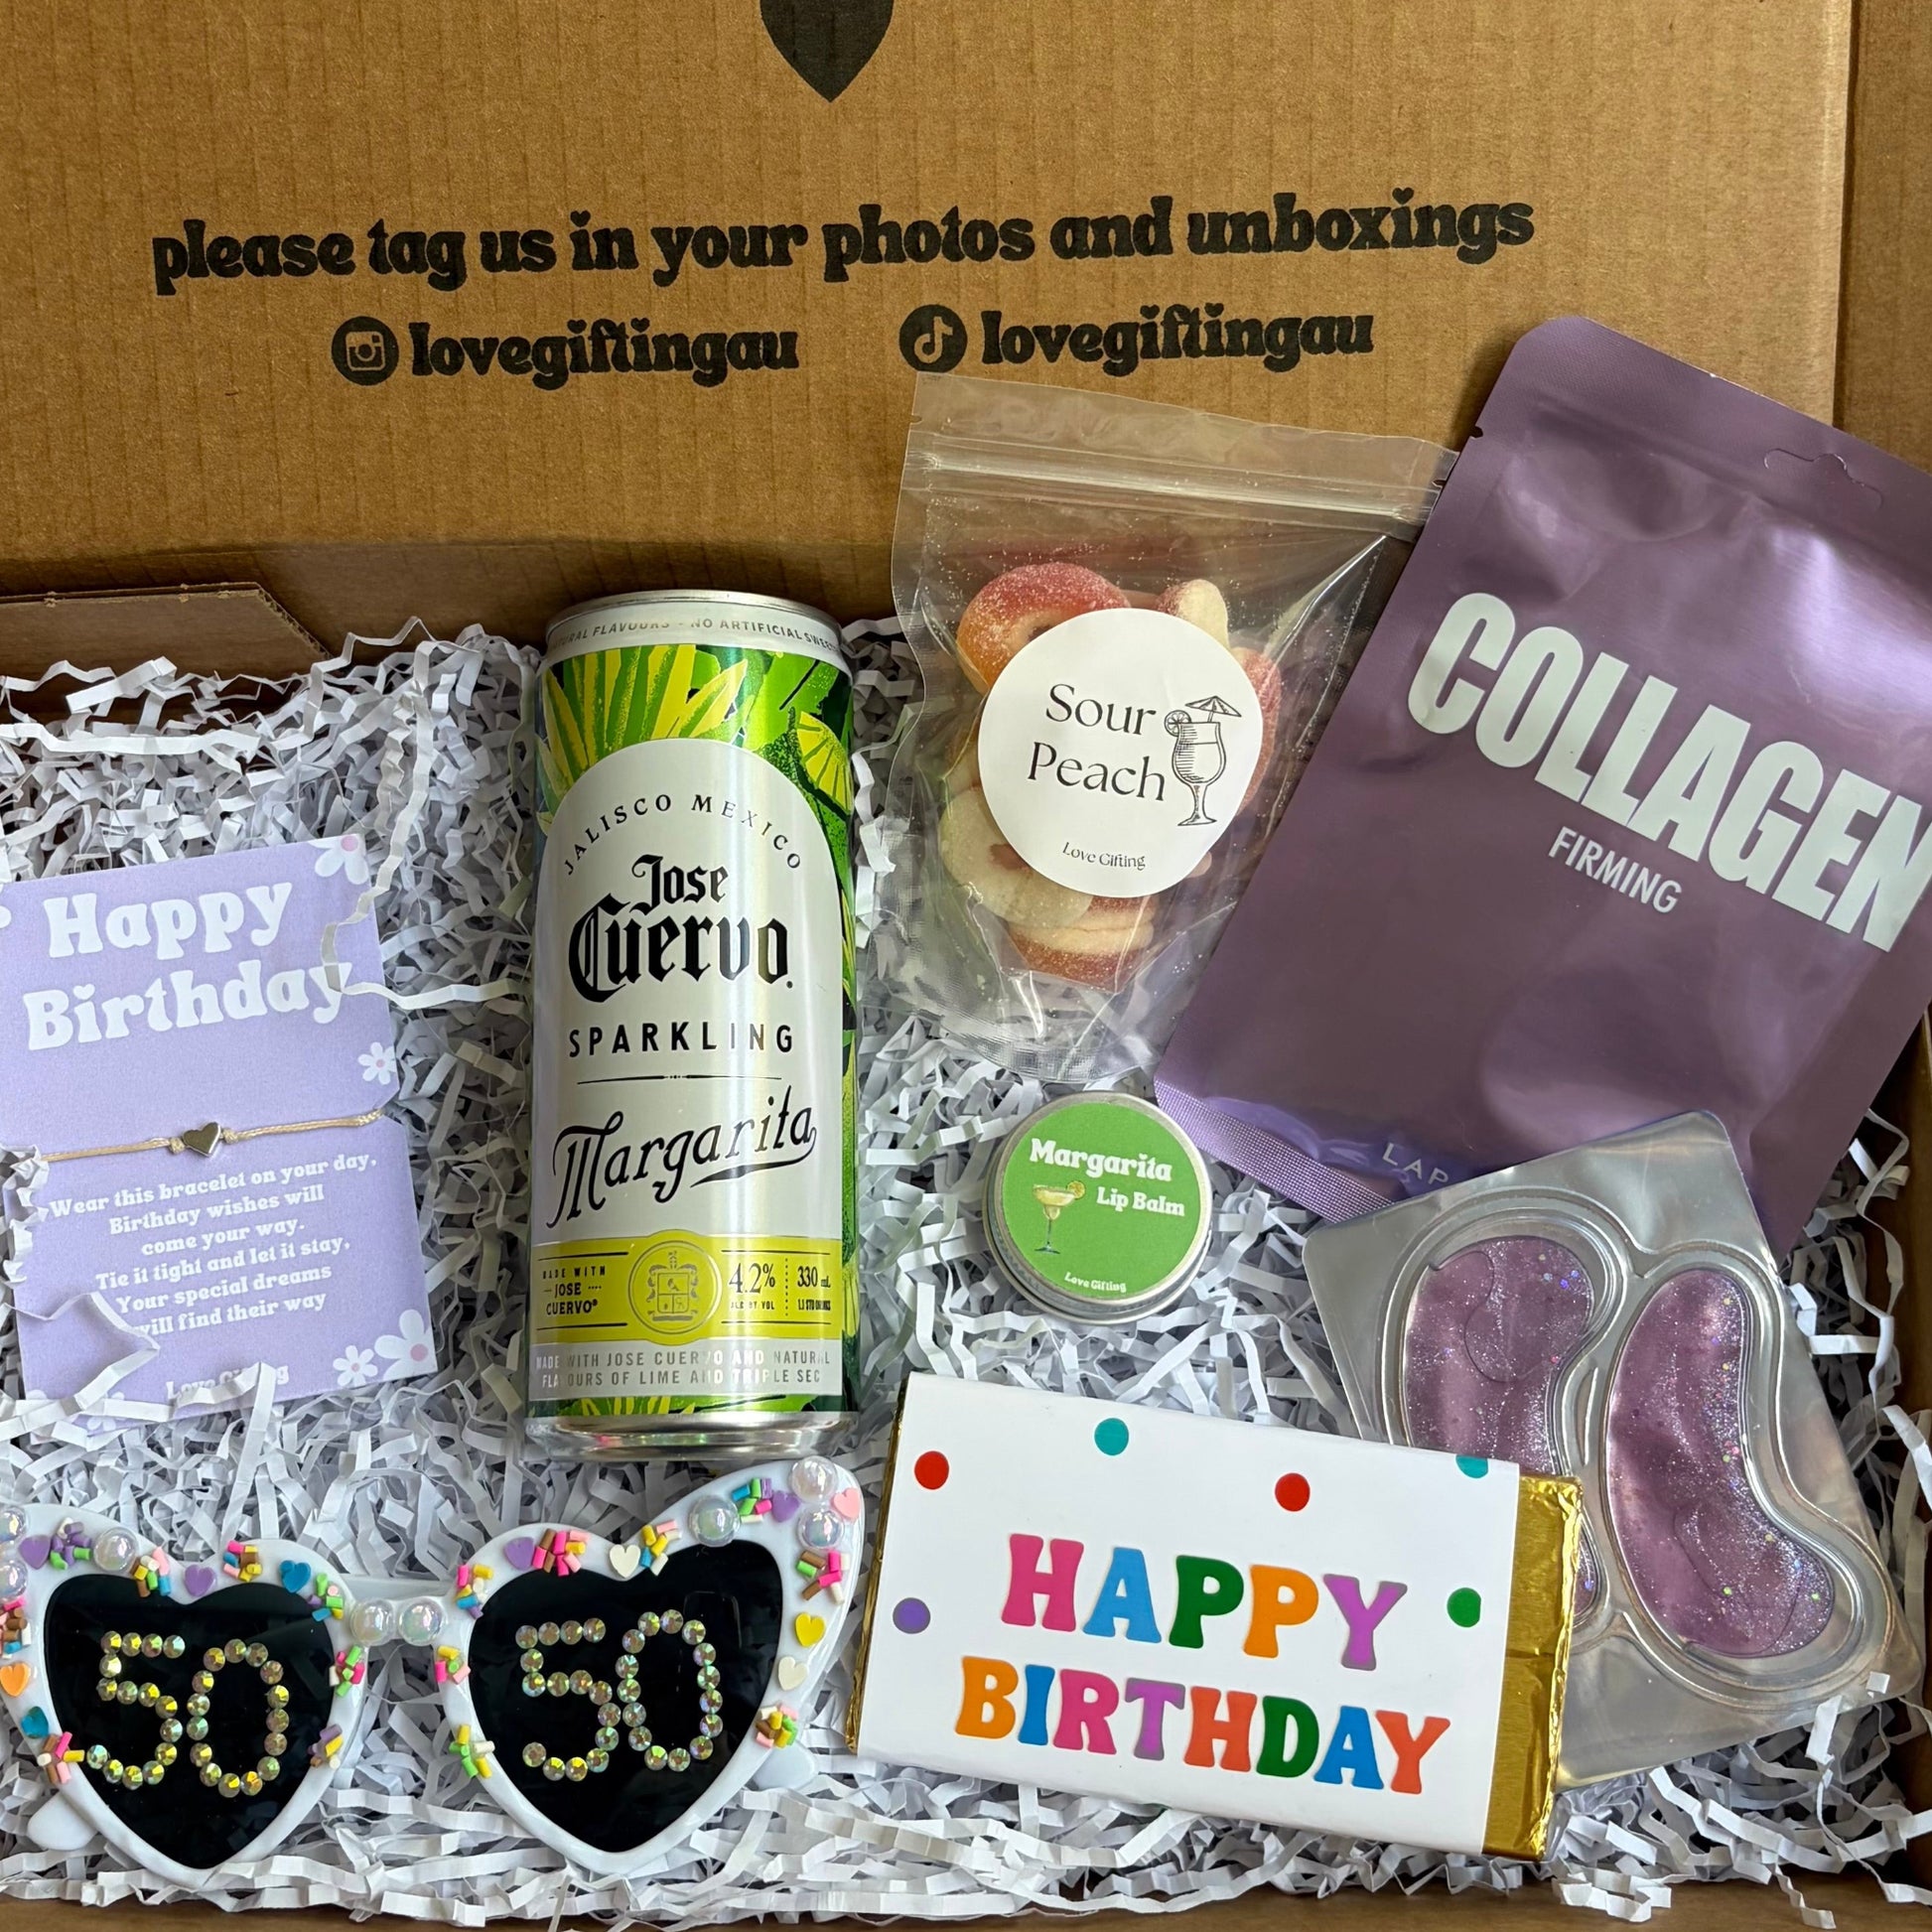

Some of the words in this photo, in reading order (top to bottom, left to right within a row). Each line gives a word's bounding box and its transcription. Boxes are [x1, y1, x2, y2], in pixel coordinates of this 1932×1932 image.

[152, 218, 355, 296] please
[367, 218, 468, 291] tag
[480, 220, 557, 274] us
[570, 209, 639, 273] in
[650, 221, 808, 287] your
[822, 203, 1036, 283] photos
[1048, 195, 1174, 259] and
[1186, 187, 1535, 265] unboxings
[408, 317, 799, 390] lovegiftingau
[981, 302, 1375, 376] lovegiftingau
[720, 620, 802, 640] ARTIFICIAL
[1045, 683, 1157, 735] Sour
[1027, 741, 1166, 801] Peach
[1407, 592, 1932, 952] COLLAGEN
[563, 794, 671, 875] JALISCO
[691, 794, 801, 869] MEXICO
[1062, 842, 1096, 864] Love
[1099, 852, 1146, 871] Gifting
[629, 854, 729, 916] Jose
[1547, 826, 1683, 914] FIRMING
[43, 882, 293, 961] Happy
[23, 959, 352, 1051] Birthday
[569, 1021, 793, 1058] SPARKLING
[546, 1085, 817, 1228] Margarita
[1030, 1138, 1173, 1181] Margarita
[50, 1197, 109, 1217] Wear
[114, 1187, 155, 1207] this
[159, 1173, 246, 1200] bracelet
[250, 1170, 276, 1184] on
[280, 1162, 329, 1184] your
[334, 1154, 376, 1172] day,
[109, 1208, 201, 1234] Birthday
[207, 1196, 280, 1218] wishes
[285, 1184, 325, 1205] will
[1096, 1185, 1129, 1212] Lip
[1132, 1191, 1185, 1216] Balm
[142, 1235, 198, 1255] come
[202, 1227, 250, 1250] your
[256, 1219, 305, 1236] way.
[95, 1272, 129, 1290] Tie
[133, 1267, 148, 1285] it
[153, 1258, 202, 1283] tight
[207, 1250, 245, 1272] and
[250, 1247, 276, 1264] let
[281, 1242, 296, 1259] it
[301, 1237, 349, 1255] stay,
[115, 1294, 169, 1313] Your
[174, 1276, 248, 1307] special
[253, 1266, 332, 1291] dreams
[574, 1266, 606, 1278] WITH
[729, 1262, 775, 1294] 4.2%
[797, 1266, 818, 1287] 330
[1063, 1272, 1090, 1290] Love
[1090, 1279, 1127, 1294] Gifting
[178, 1308, 222, 1330] find
[226, 1300, 279, 1322] their
[284, 1293, 327, 1311] way
[555, 1283, 581, 1299] JOSE
[761, 1301, 774, 1311] VOL
[542, 1372, 603, 1388] FLAOURS
[611, 1371, 629, 1386] OF
[639, 1370, 680, 1384] LIME
[797, 1369, 820, 1383] SEC
[607, 1352, 644, 1366] JOSE
[732, 1349, 764, 1365] AND
[1000, 1533, 1408, 1671] HAPPY
[85, 1629, 290, 1798] 50
[515, 1609, 725, 1783] 50
[954, 1655, 1450, 1795] BIRTHDAY
